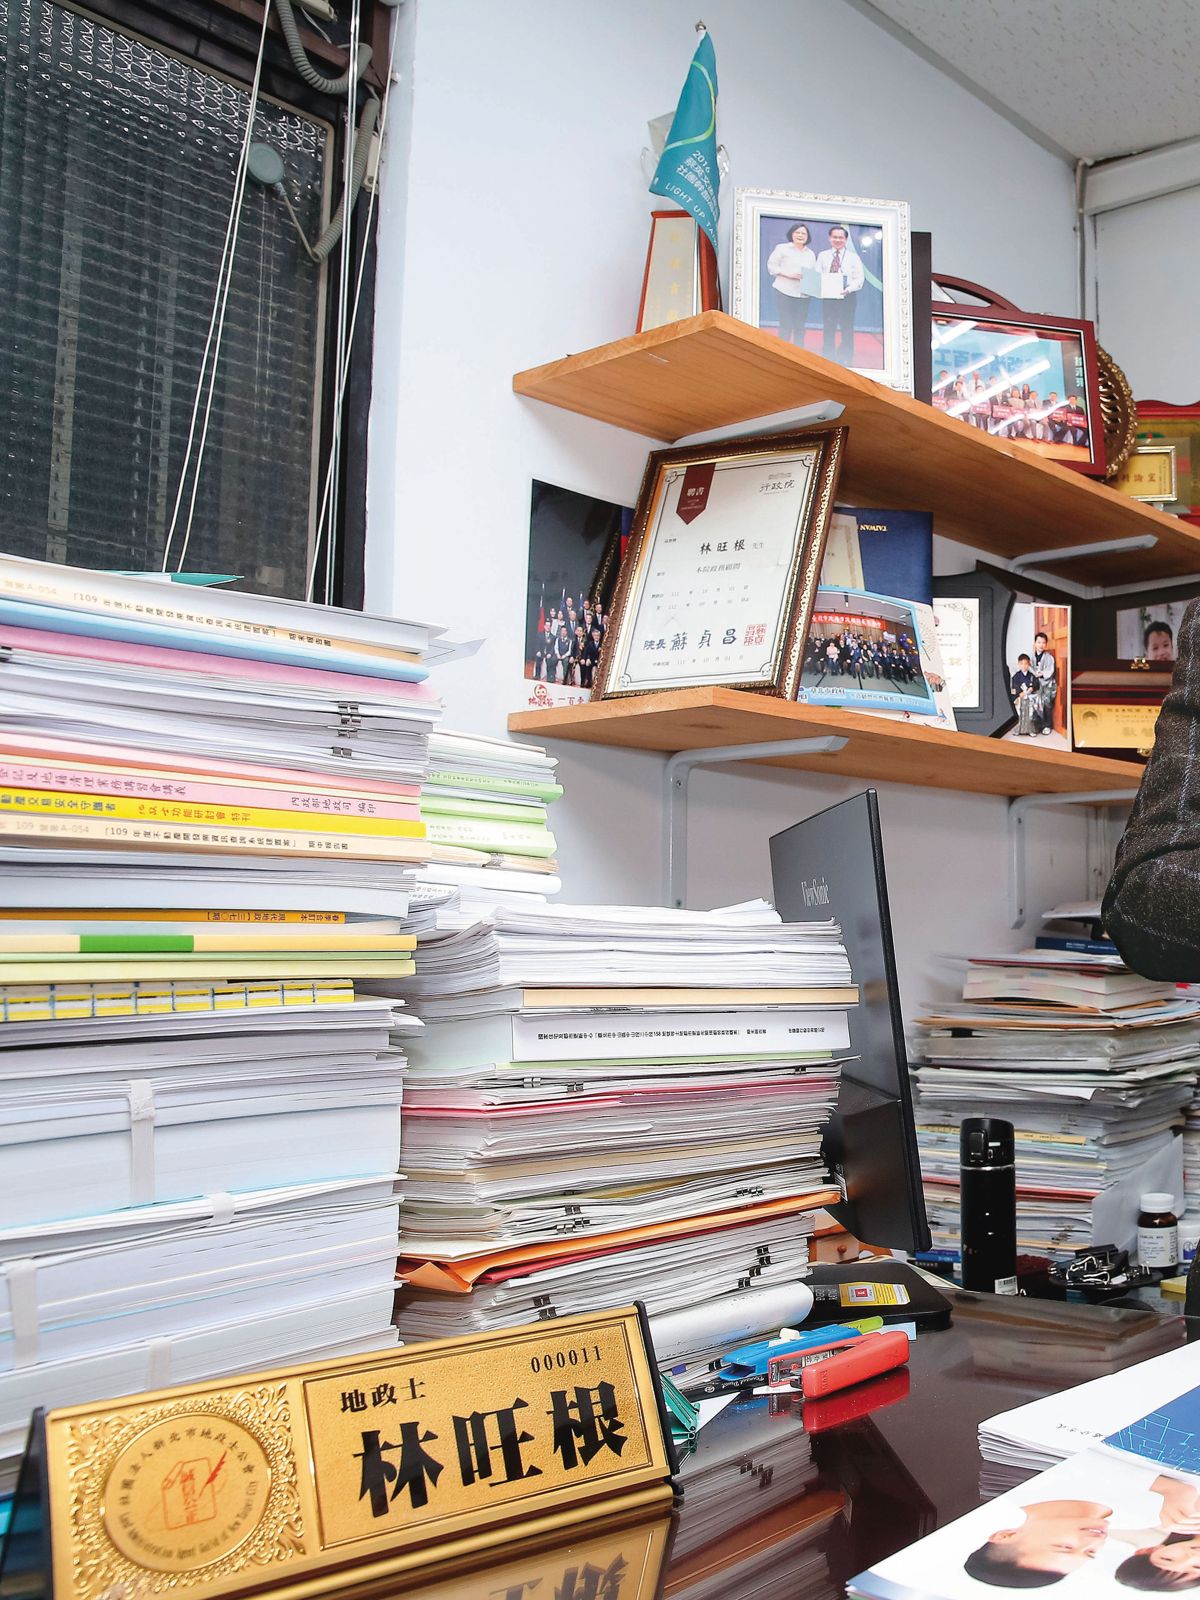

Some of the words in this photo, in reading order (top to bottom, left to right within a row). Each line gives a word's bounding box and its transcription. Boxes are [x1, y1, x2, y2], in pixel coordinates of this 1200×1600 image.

[692, 150, 710, 173] 2016
[665, 182, 693, 203] LIGHT
[693, 205, 706, 218] UP
[759, 479, 795, 493] 行政院
[859, 524, 888, 532] TAIWAN
[700, 539, 746, 555] 林旺根
[531, 1345, 602, 1373] 000011
[340, 1377, 427, 1414] 地政士
[353, 1380, 628, 1518] 林旺根
